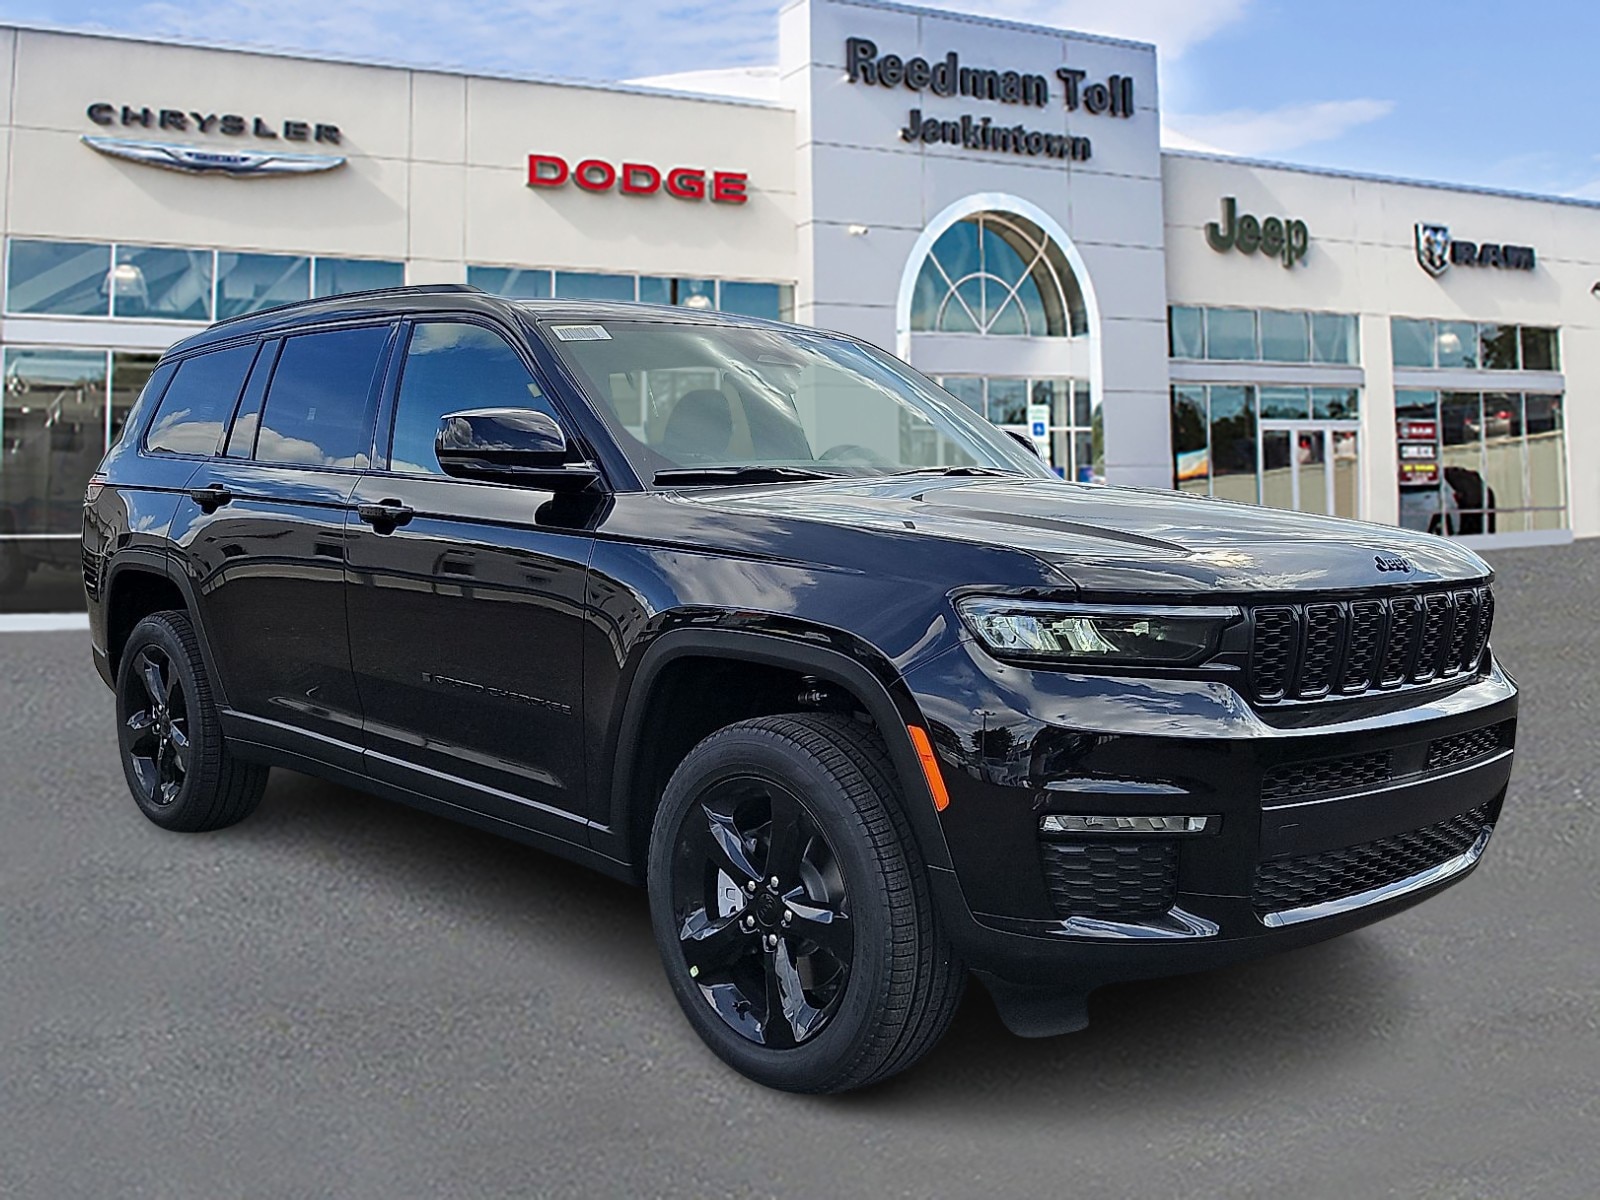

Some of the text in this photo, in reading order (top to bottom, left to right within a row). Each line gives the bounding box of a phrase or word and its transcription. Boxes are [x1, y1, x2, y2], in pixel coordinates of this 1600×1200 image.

[846, 37, 1135, 119] Reedman Toll
[86, 102, 342, 145] CHRYSLER
[901, 109, 1092, 162] Jenkintown
[527, 153, 749, 204] DODGE
[1204, 196, 1308, 270] Jeep
[1450, 240, 1536, 271] RAM
[1373, 555, 1411, 574] Jeep
